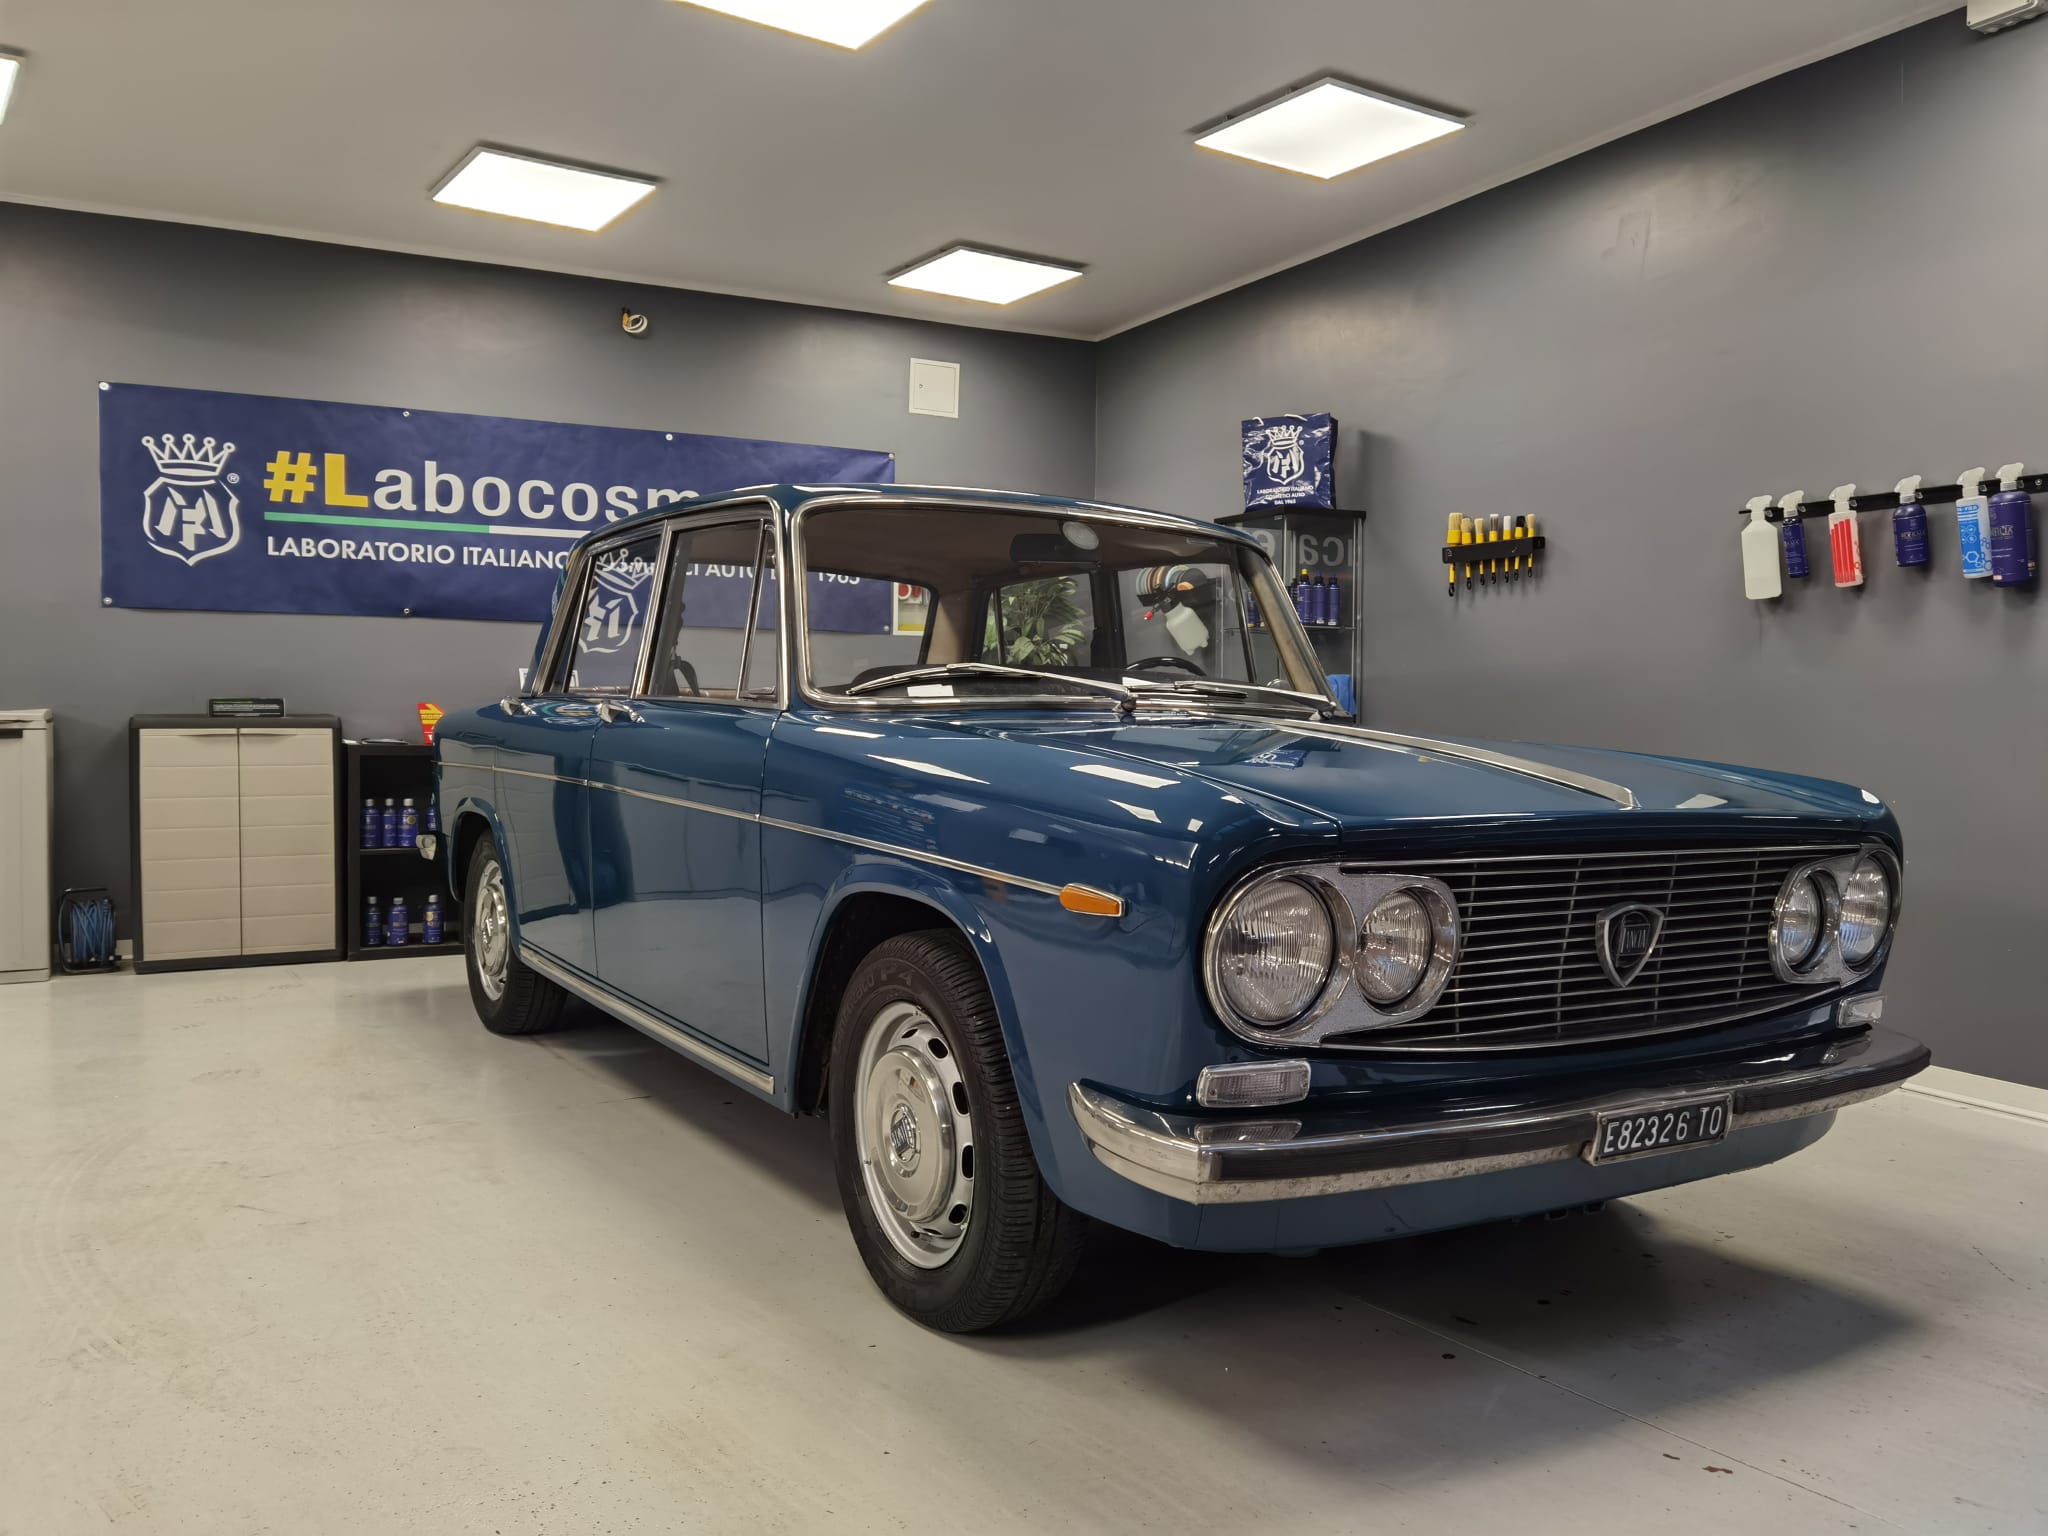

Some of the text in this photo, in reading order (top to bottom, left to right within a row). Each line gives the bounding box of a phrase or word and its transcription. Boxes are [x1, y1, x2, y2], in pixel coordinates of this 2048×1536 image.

[266, 535, 456, 566] LABORATORIO
[462, 545, 569, 570] ITALIANO
[1603, 1105, 1722, 1154] E82326 TO
